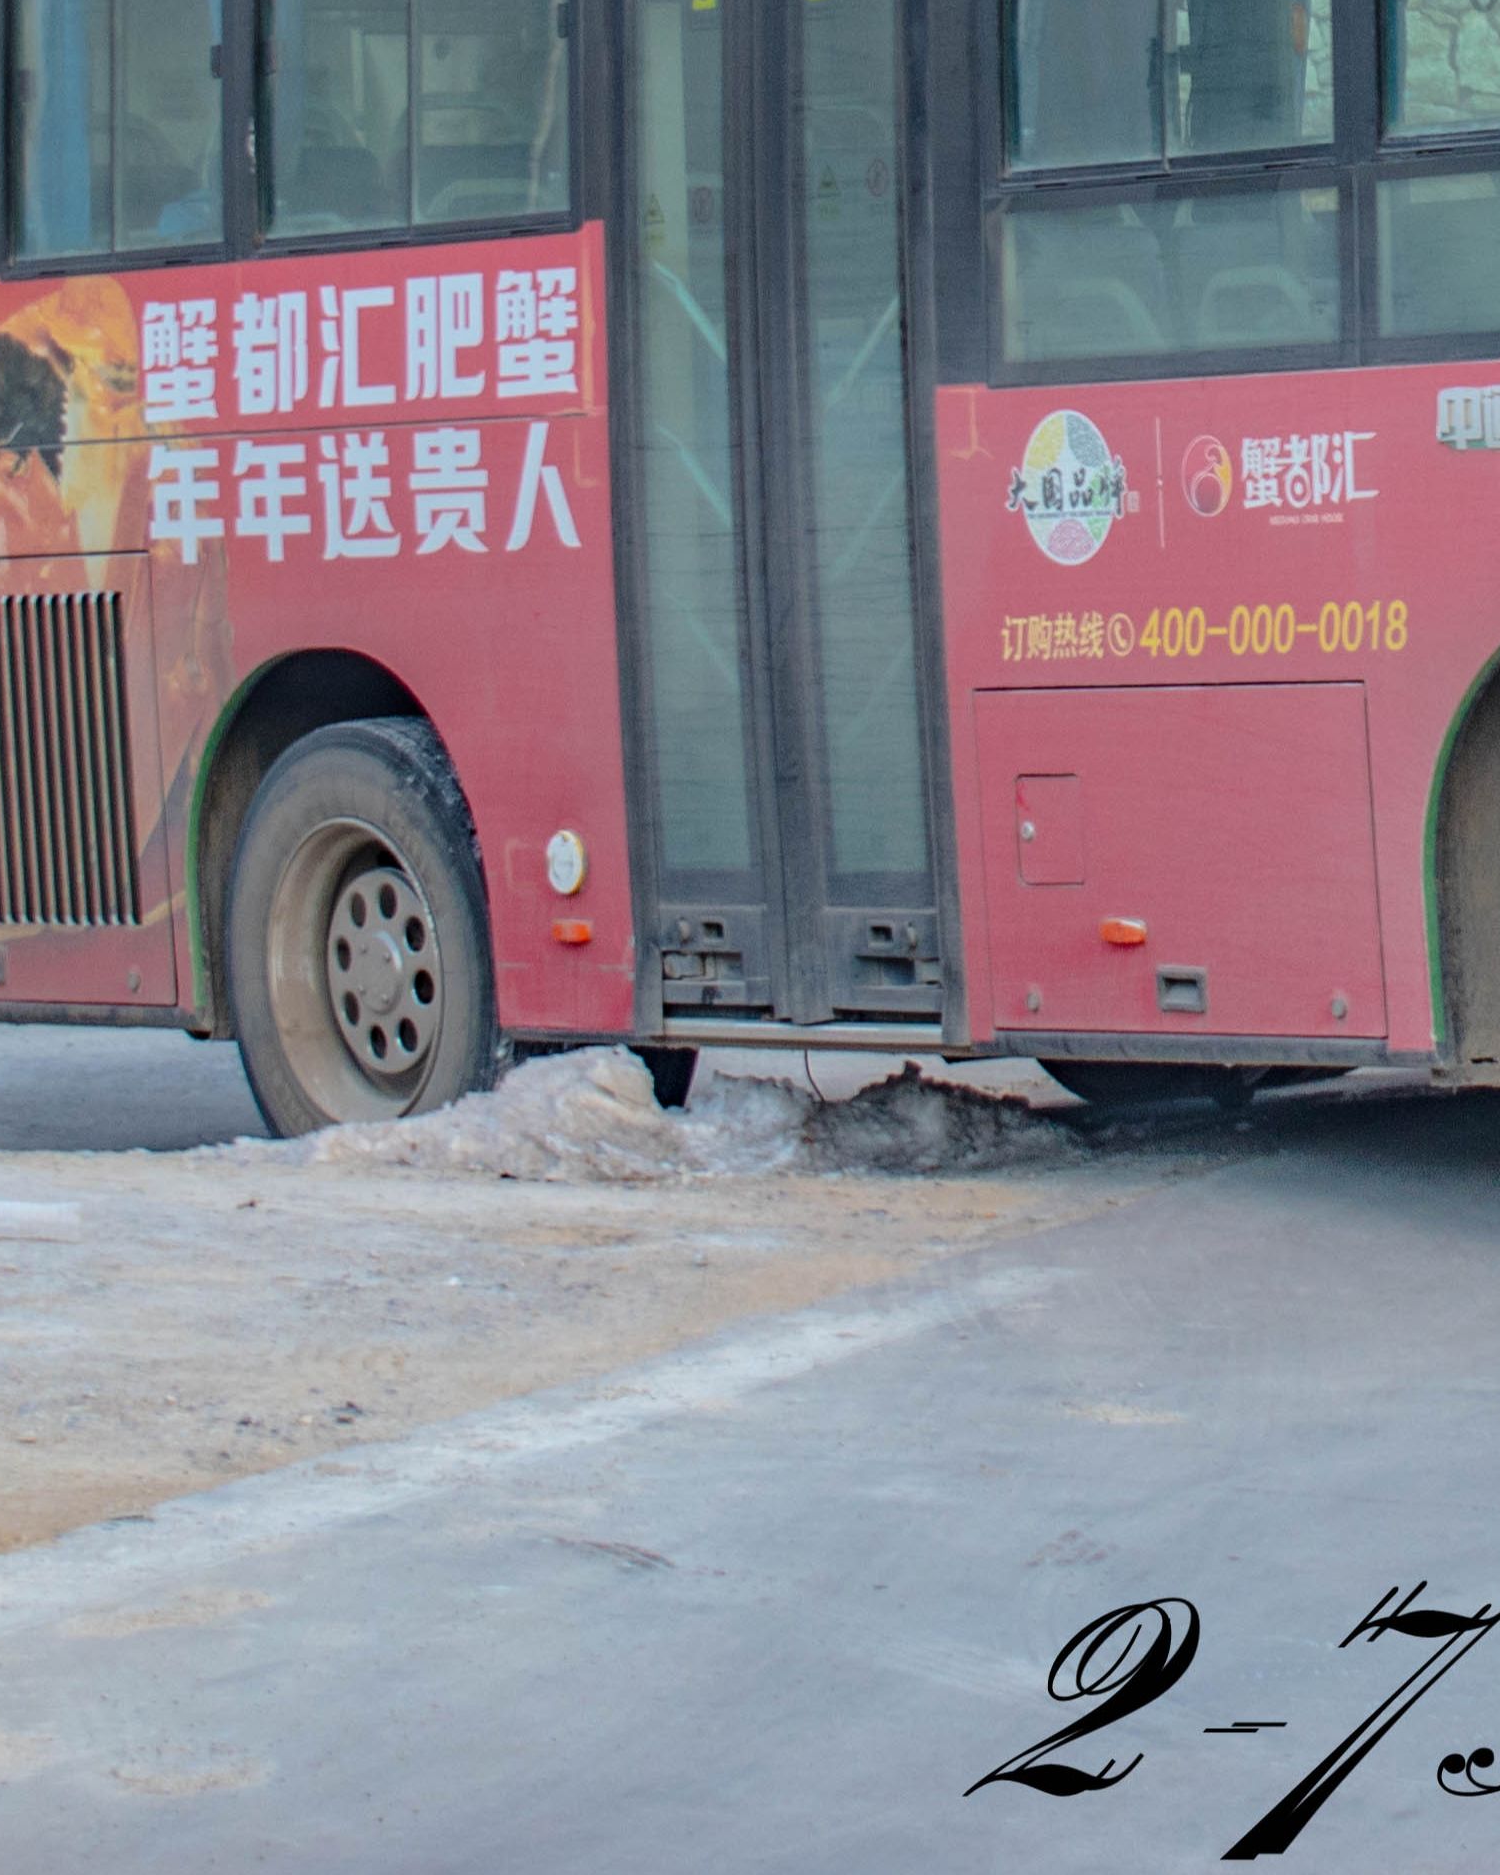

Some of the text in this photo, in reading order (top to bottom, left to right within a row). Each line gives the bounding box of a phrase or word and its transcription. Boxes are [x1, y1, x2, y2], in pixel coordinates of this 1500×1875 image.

[141, 266, 579, 425] 蟹都汇肥蟹
[147, 421, 583, 565] 年年送贵人
[1241, 430, 1380, 510] 蟹都汇
[1002, 599, 1409, 662] 订购热线 400-000-0018
